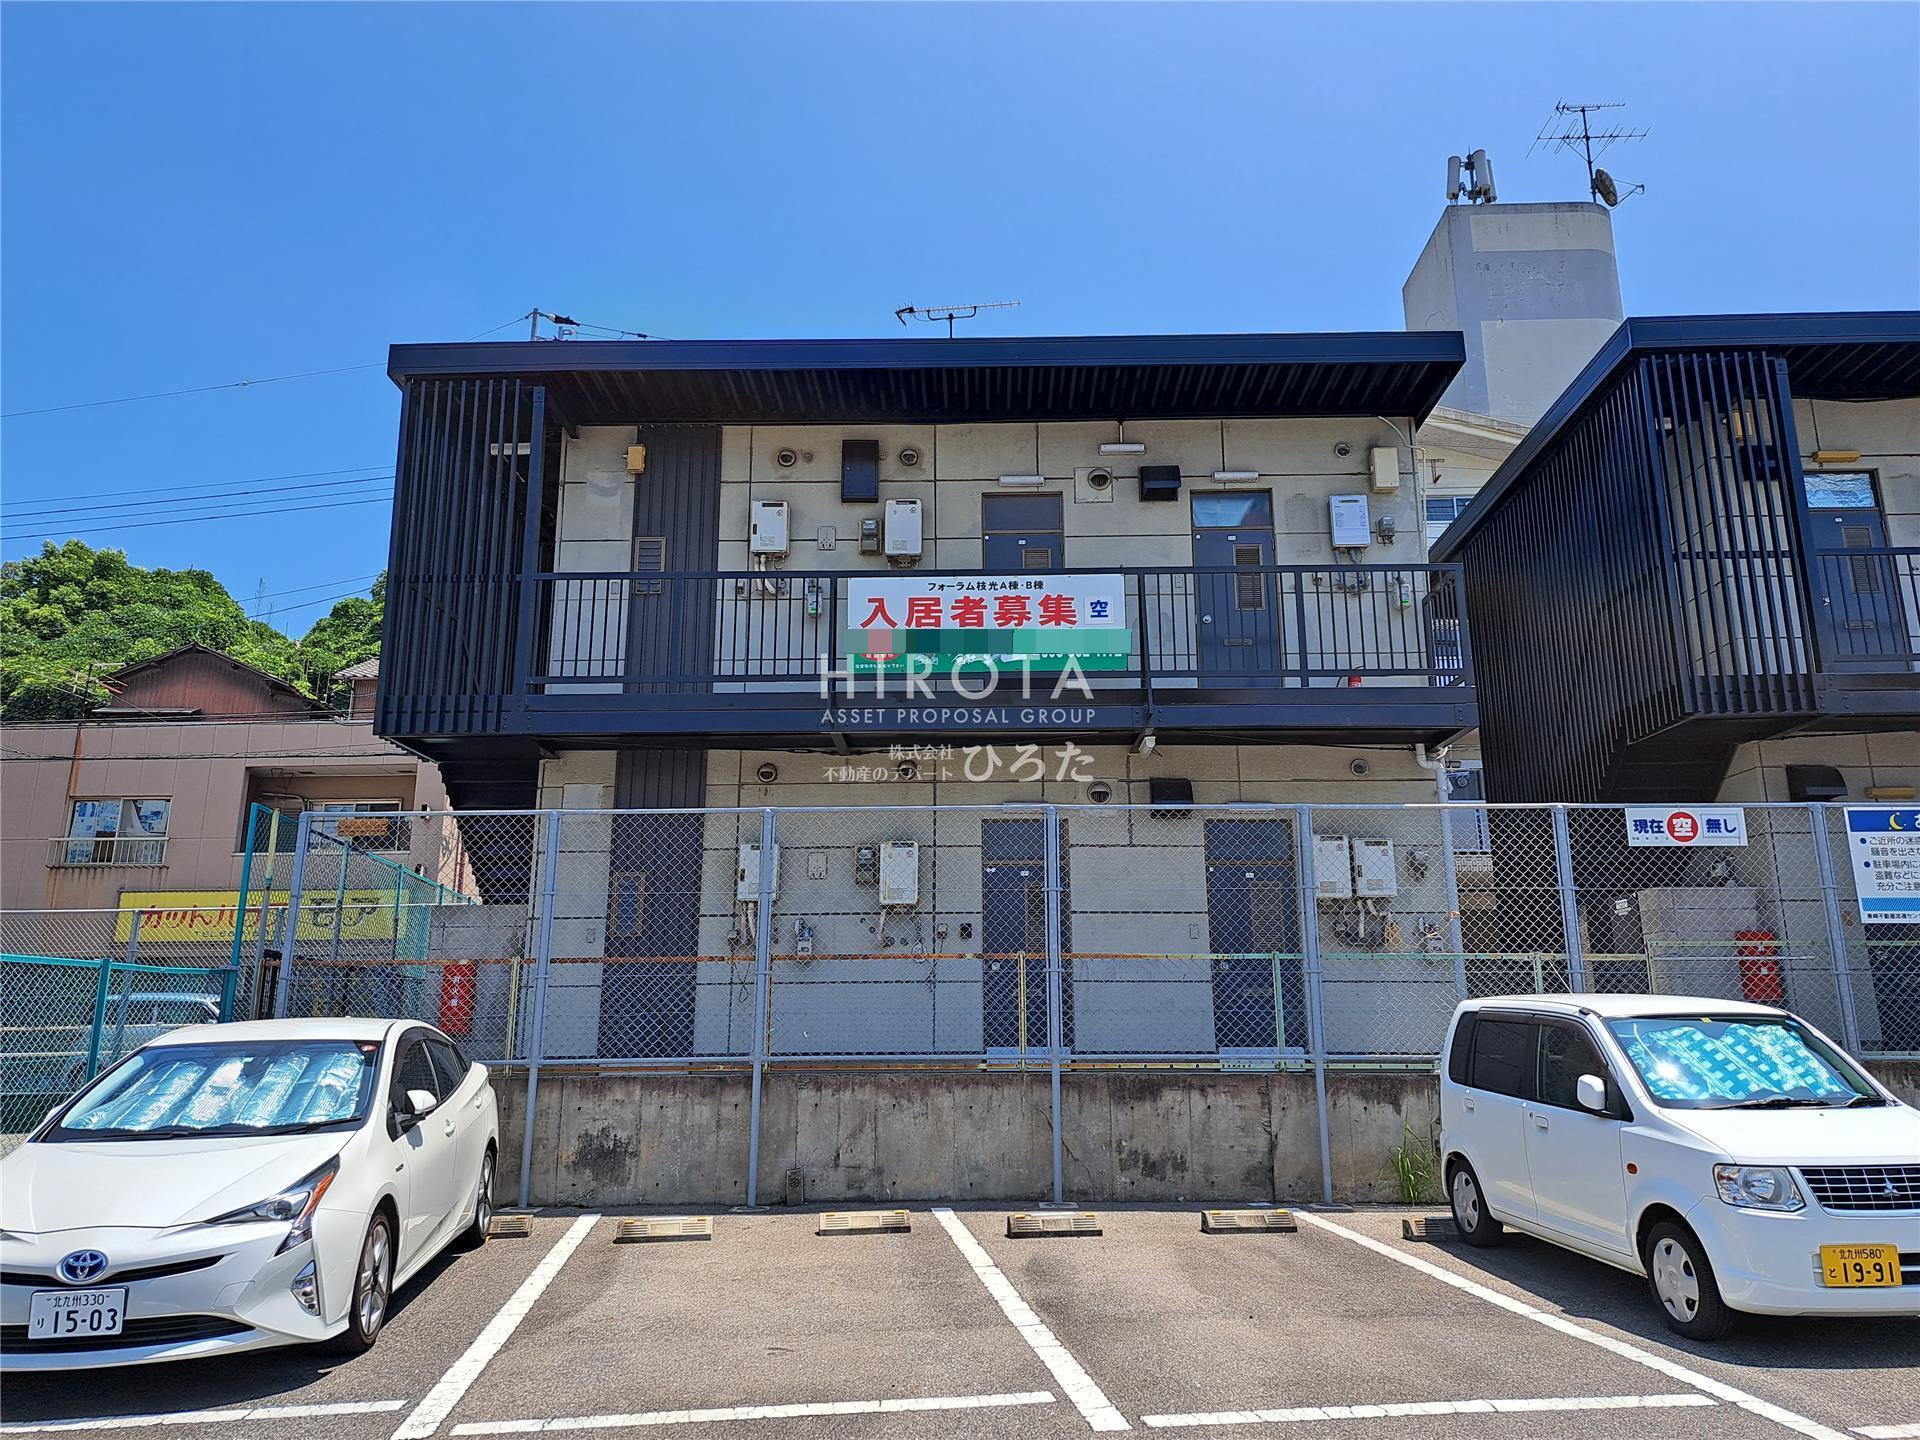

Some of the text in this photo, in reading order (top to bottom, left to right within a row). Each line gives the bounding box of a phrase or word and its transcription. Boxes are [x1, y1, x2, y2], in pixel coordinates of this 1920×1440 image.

[859, 593, 1109, 629] 入居者募集 空
[1633, 817, 1737, 837] 現在 空 無し
[1839, 1248, 1882, 1260] 北九州580
[1829, 1262, 1895, 1283] と 19-91
[53, 1294, 105, 1308] 北九州330
[37, 1308, 118, 1334] り 15-03
